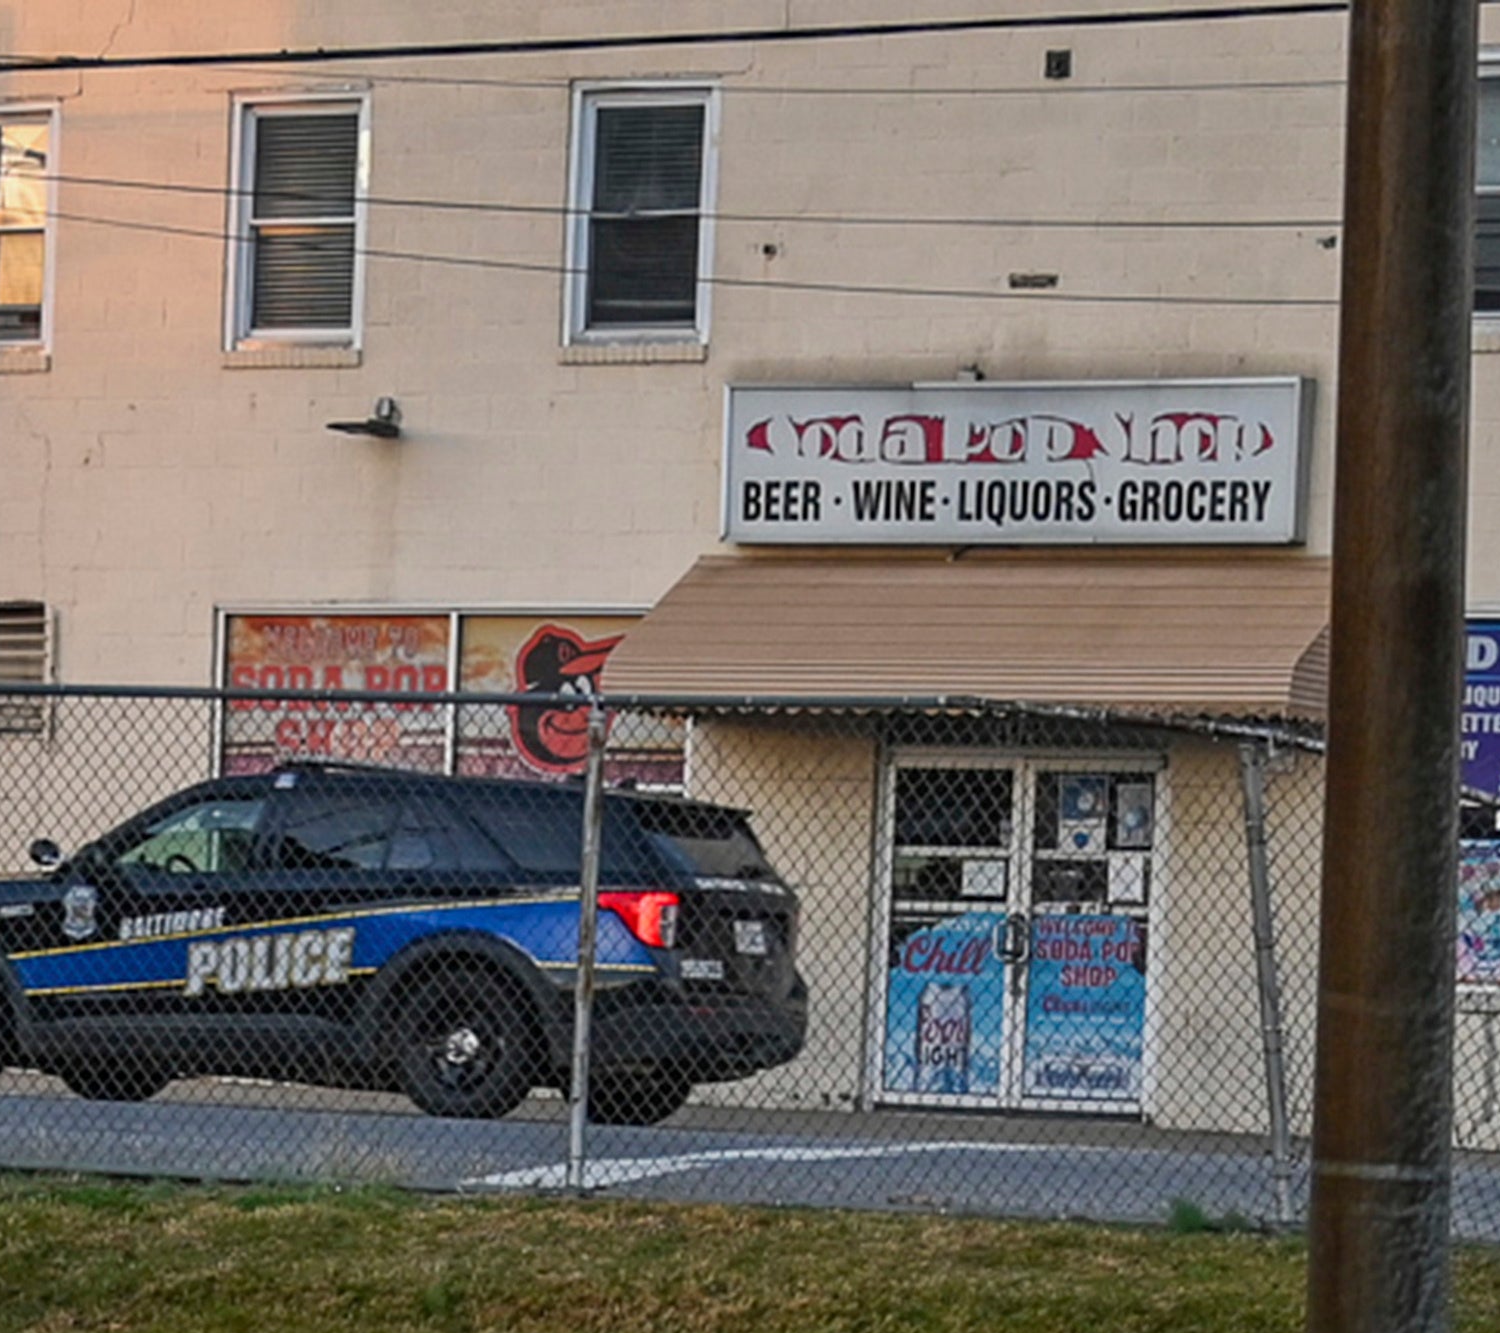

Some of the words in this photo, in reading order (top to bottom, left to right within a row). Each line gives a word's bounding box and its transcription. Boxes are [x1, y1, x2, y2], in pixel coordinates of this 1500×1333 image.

[742, 480, 821, 521] BEER
[853, 480, 937, 521] WINE
[957, 480, 1096, 525] LIQUORS
[1117, 480, 1273, 522] GROCERY
[230, 665, 350, 711] SODA
[364, 665, 448, 711] POP
[119, 907, 226, 940] BALTIMORE
[184, 927, 356, 997] POLICE
[904, 934, 993, 974] Chill
[1036, 940, 1092, 962] SODA
[1060, 966, 1118, 988] SHOP
